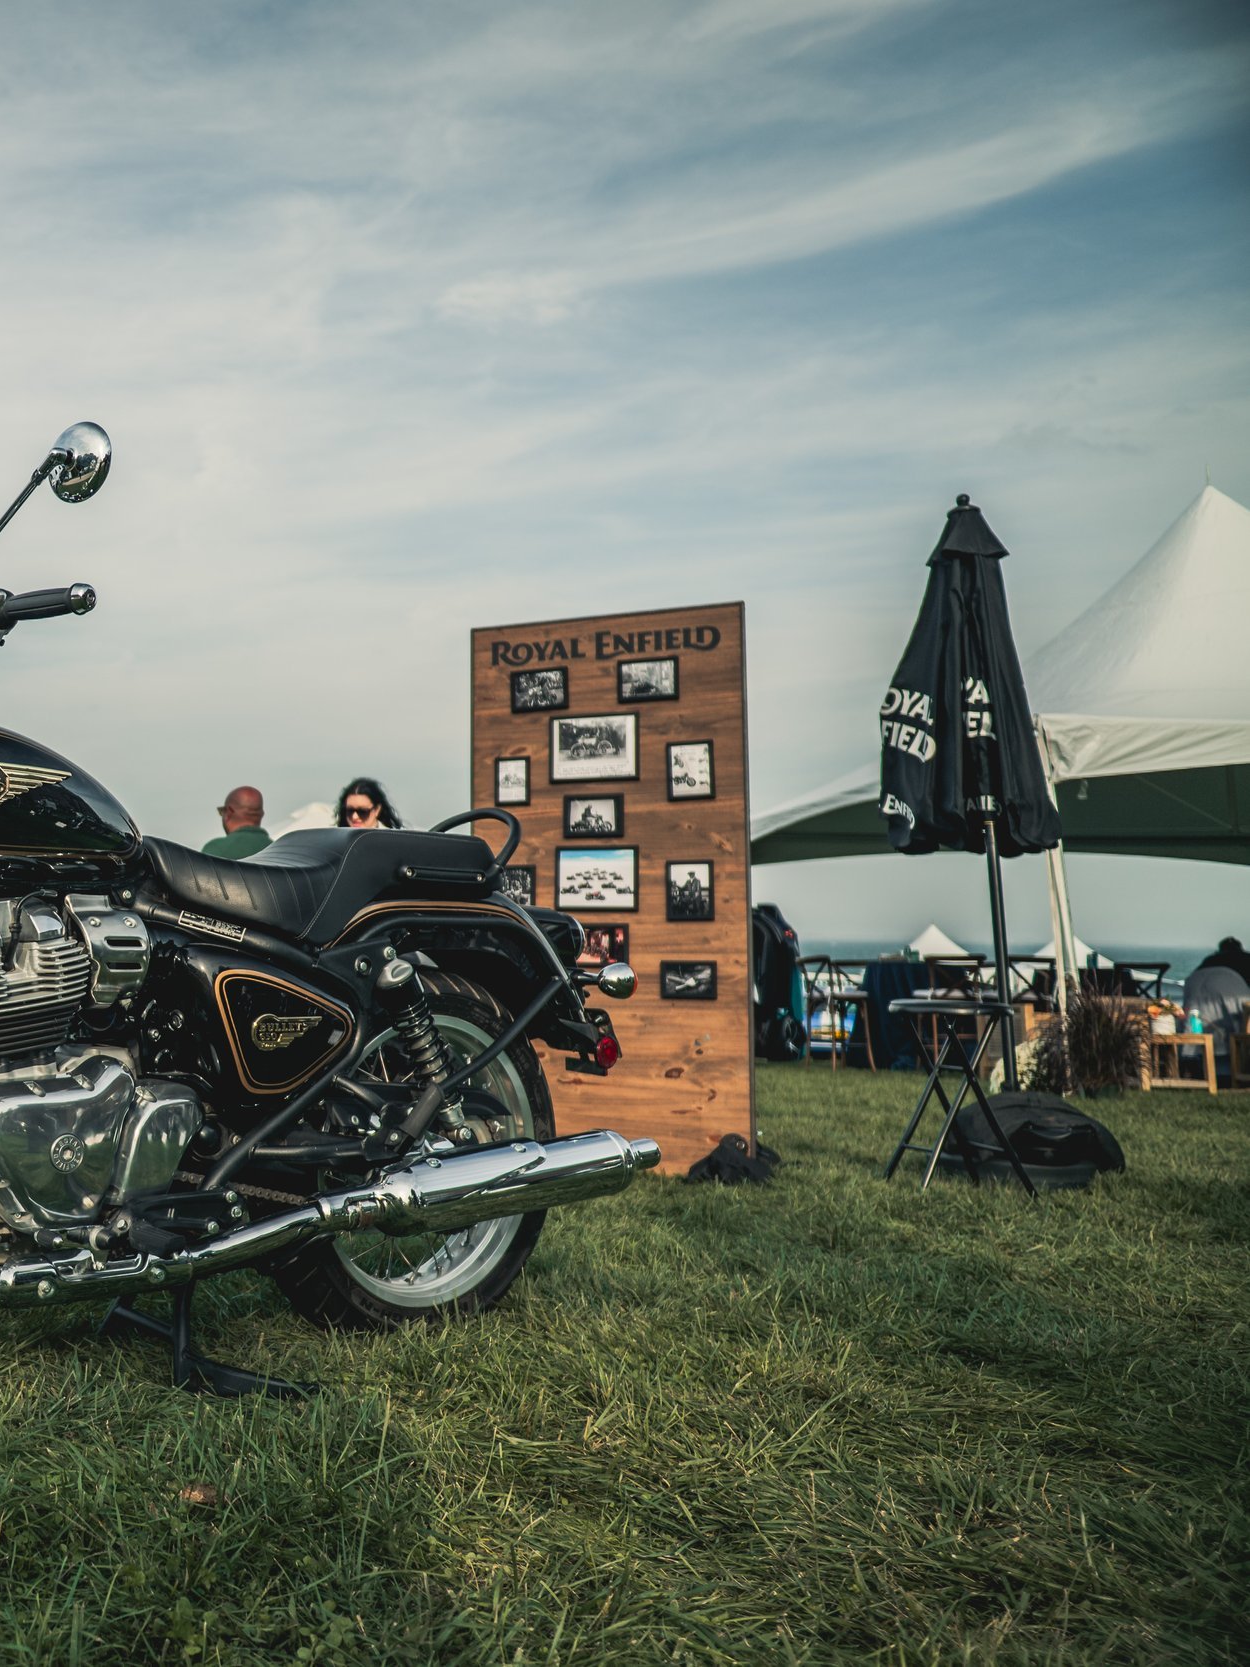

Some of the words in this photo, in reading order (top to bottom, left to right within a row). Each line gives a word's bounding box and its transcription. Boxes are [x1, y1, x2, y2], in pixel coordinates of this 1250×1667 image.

[491, 638, 586, 667] ROYAL
[595, 625, 721, 661] ENFIELD
[880, 687, 933, 726] OYAL
[881, 720, 936, 763] FIELD
[259, 1022, 303, 1032] BULLET
[259, 1032, 278, 1041] 650
[58, 1138, 81, 1151] ROYAL
[53, 1153, 81, 1170] ENFIELD
